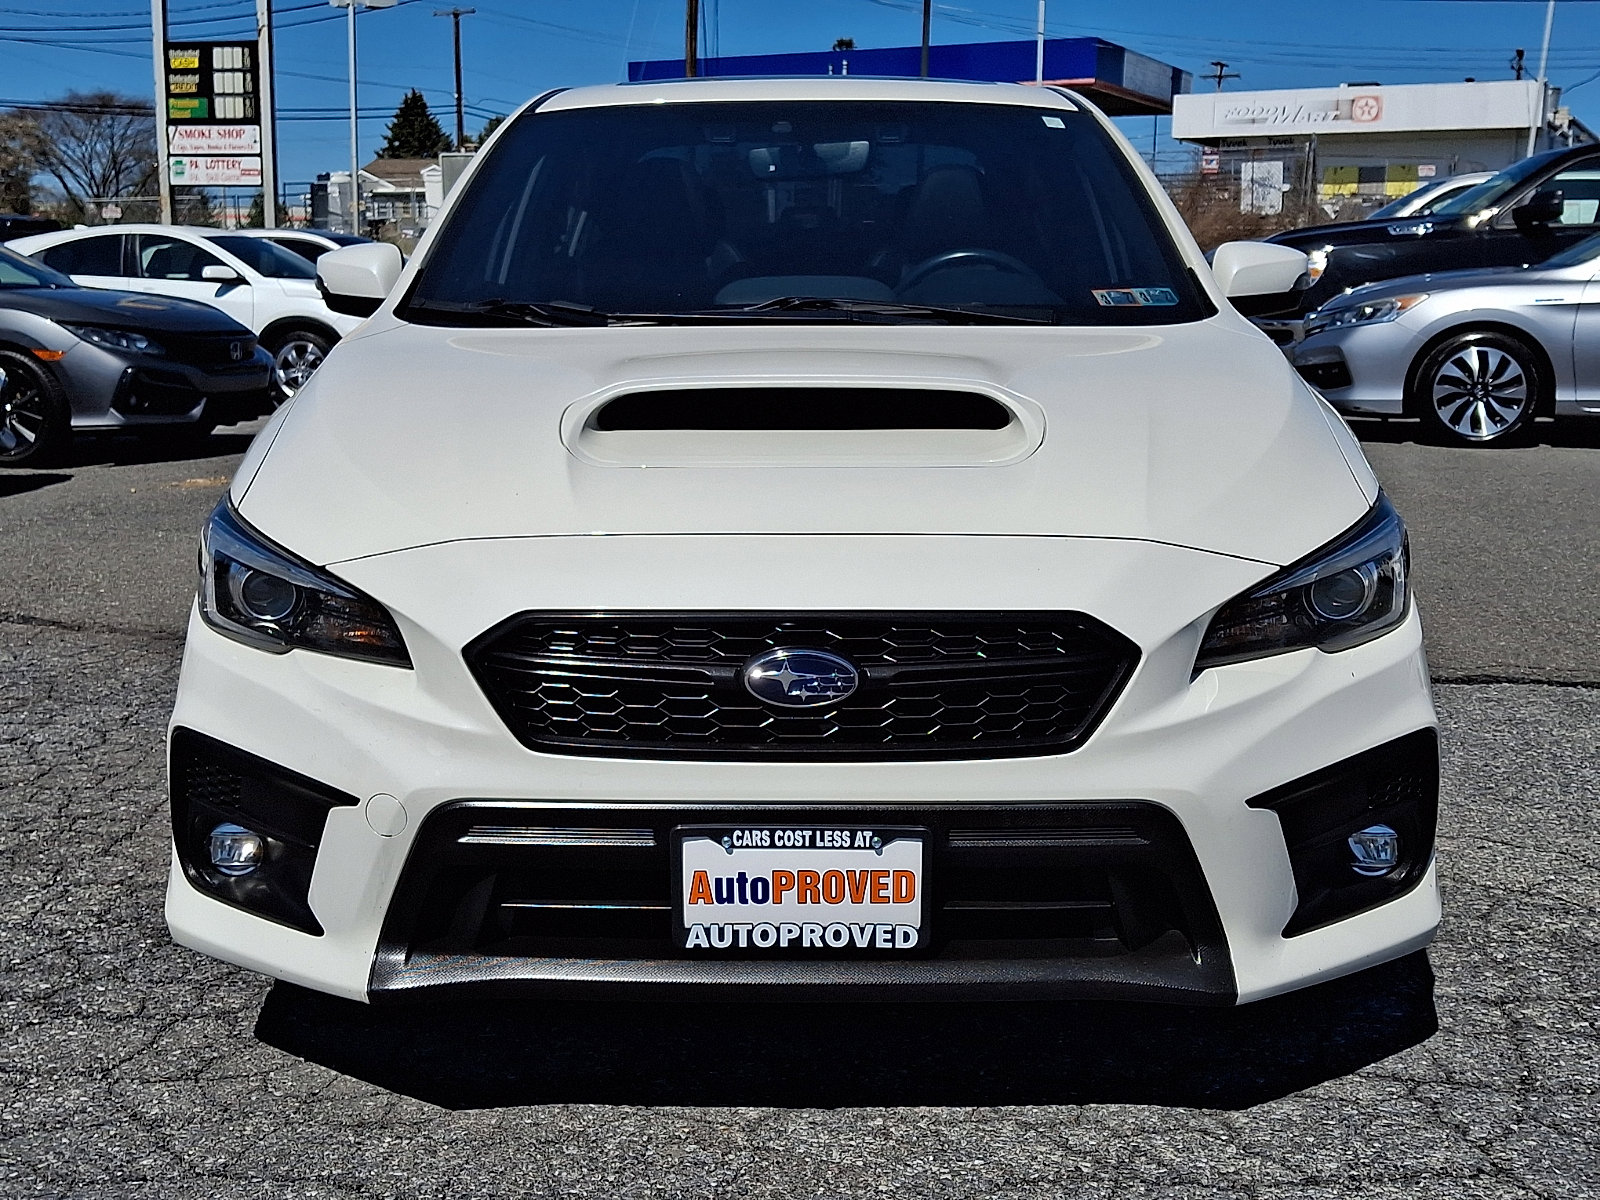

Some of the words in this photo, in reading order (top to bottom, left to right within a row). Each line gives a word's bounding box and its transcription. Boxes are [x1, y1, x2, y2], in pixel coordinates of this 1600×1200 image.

[178, 128, 211, 139] SMOKE
[217, 128, 246, 140] SHOP
[205, 159, 242, 170] LOTTERY
[732, 830, 771, 847] CARS
[774, 830, 812, 847] COST
[816, 831, 850, 848] LESS
[854, 831, 873, 848] AT
[688, 869, 916, 905] AutoPROVED
[685, 923, 919, 948] AUTOPROVED
